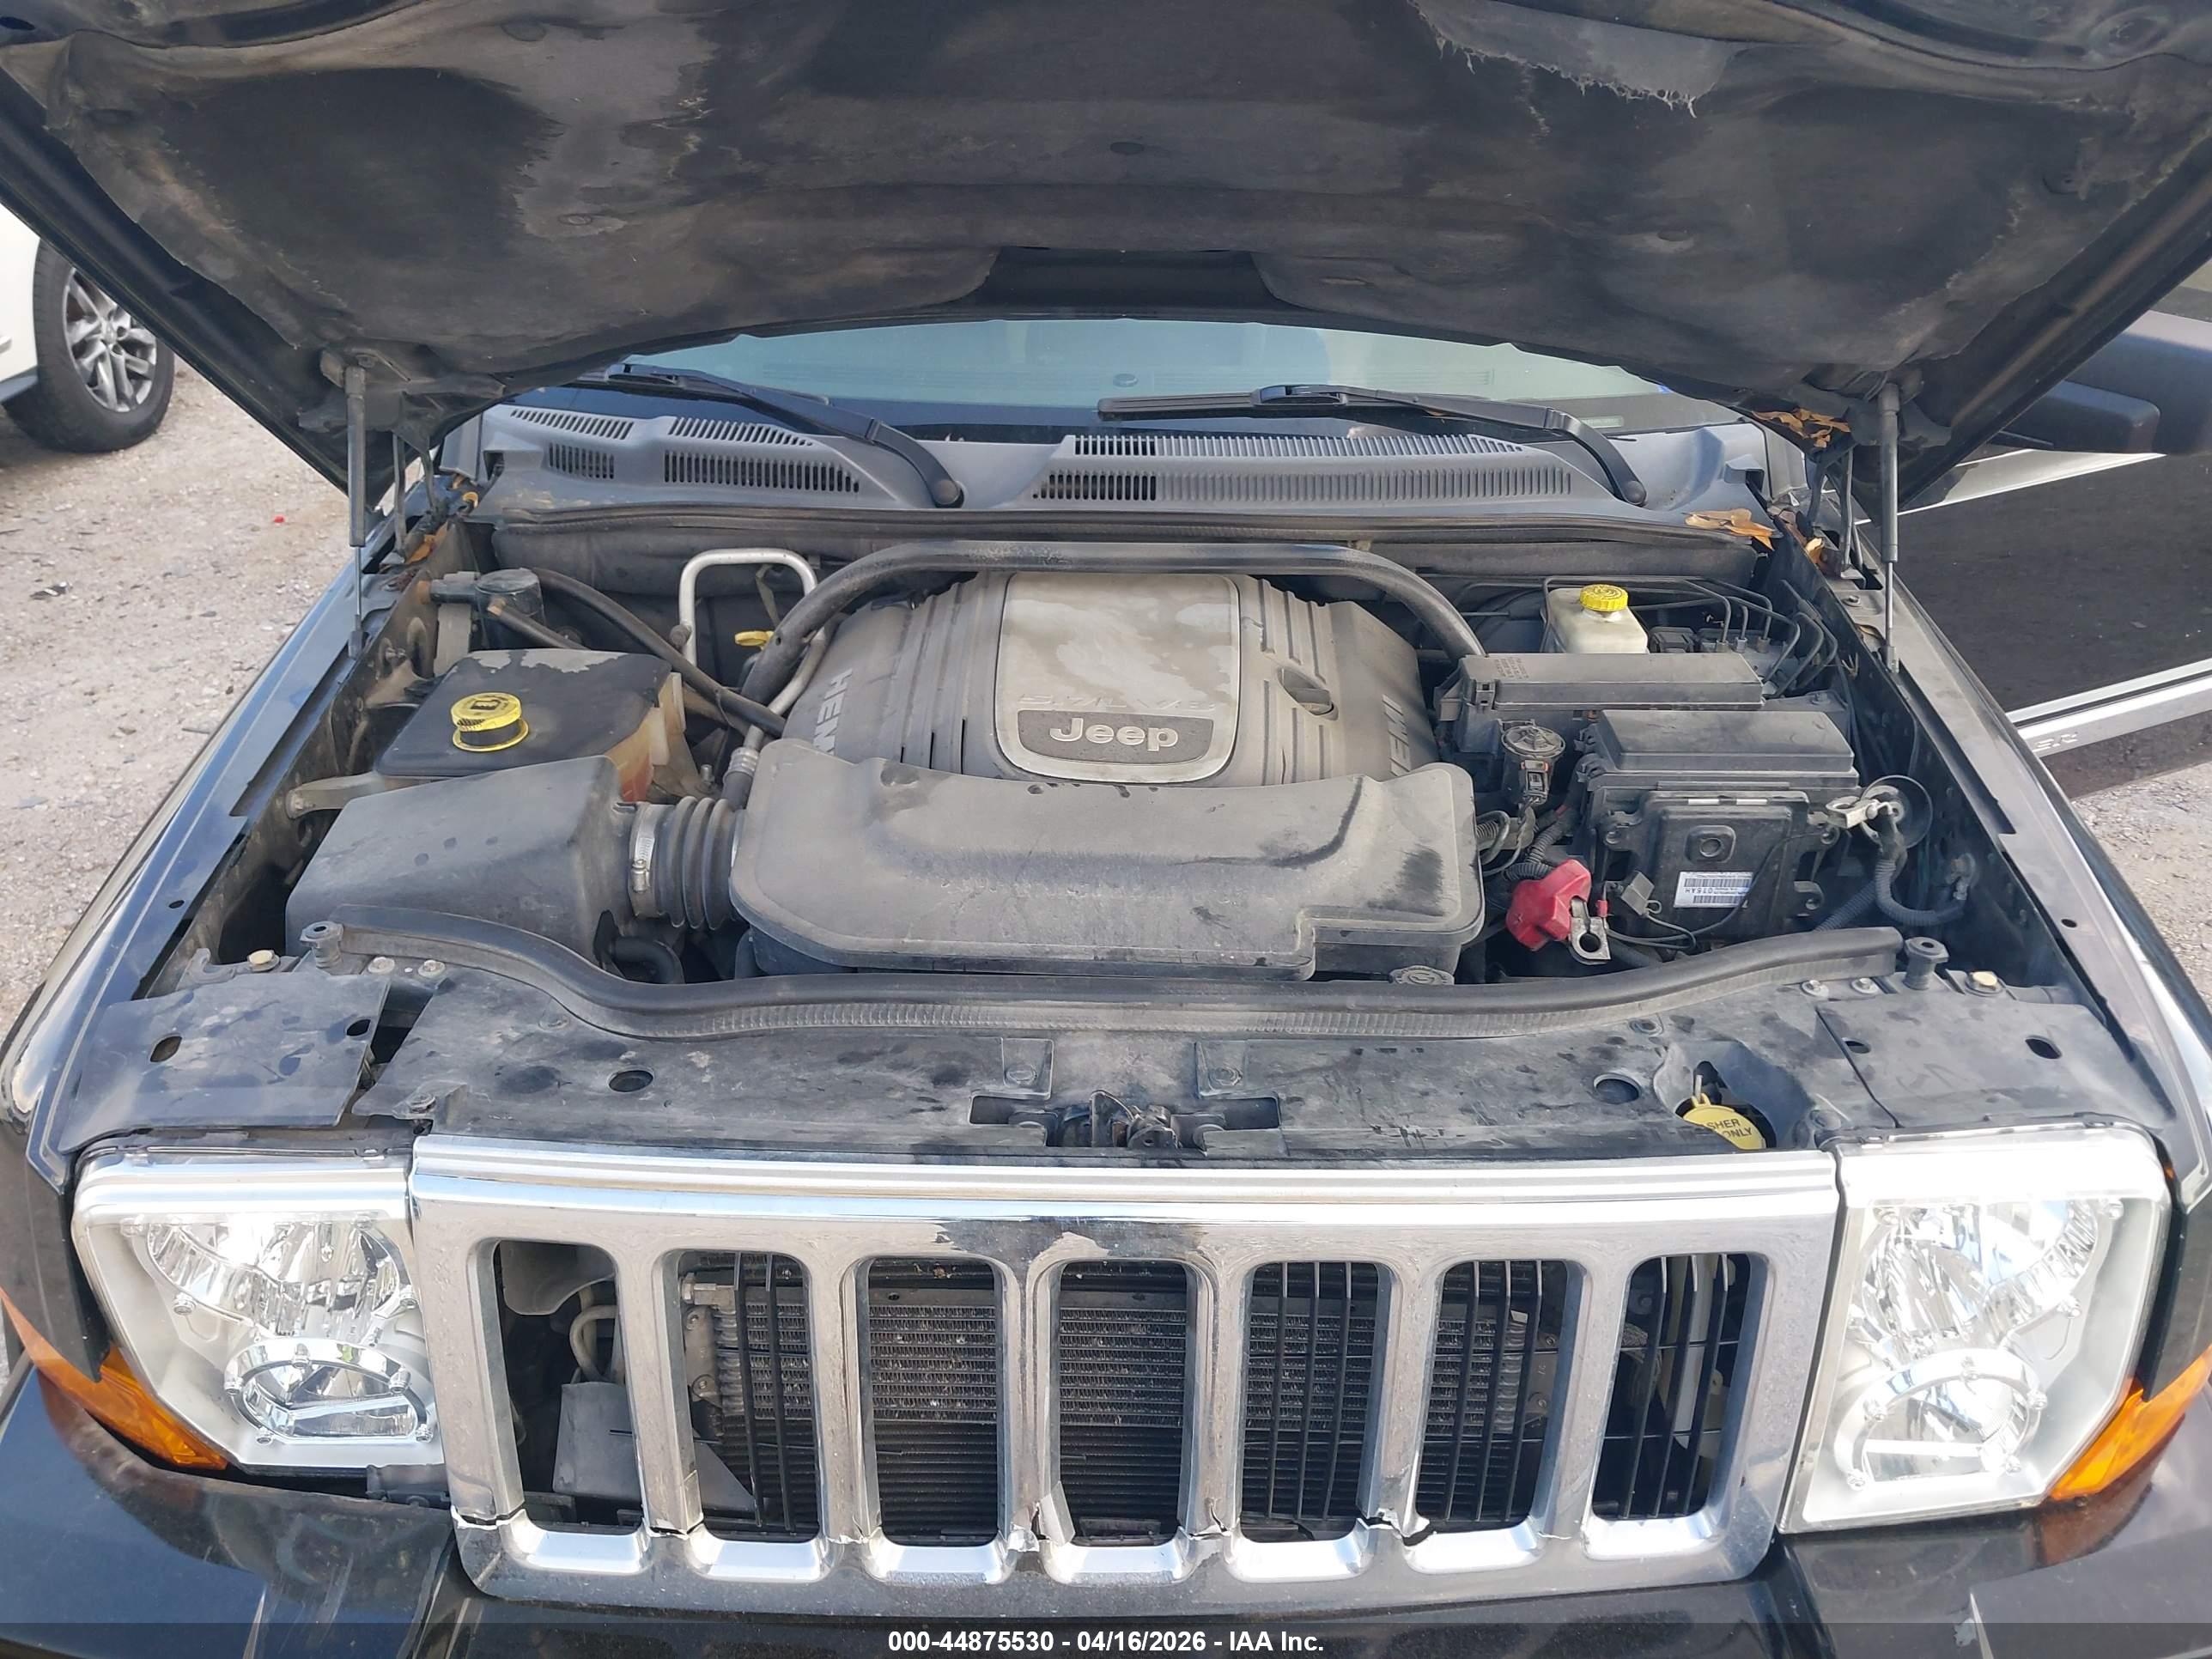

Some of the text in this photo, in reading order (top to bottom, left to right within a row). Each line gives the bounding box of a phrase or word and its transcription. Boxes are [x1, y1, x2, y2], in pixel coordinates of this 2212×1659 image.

[812, 668, 853, 756] HEM
[1048, 717, 1180, 752] Jeep
[1705, 1118, 1741, 1130] SHER
